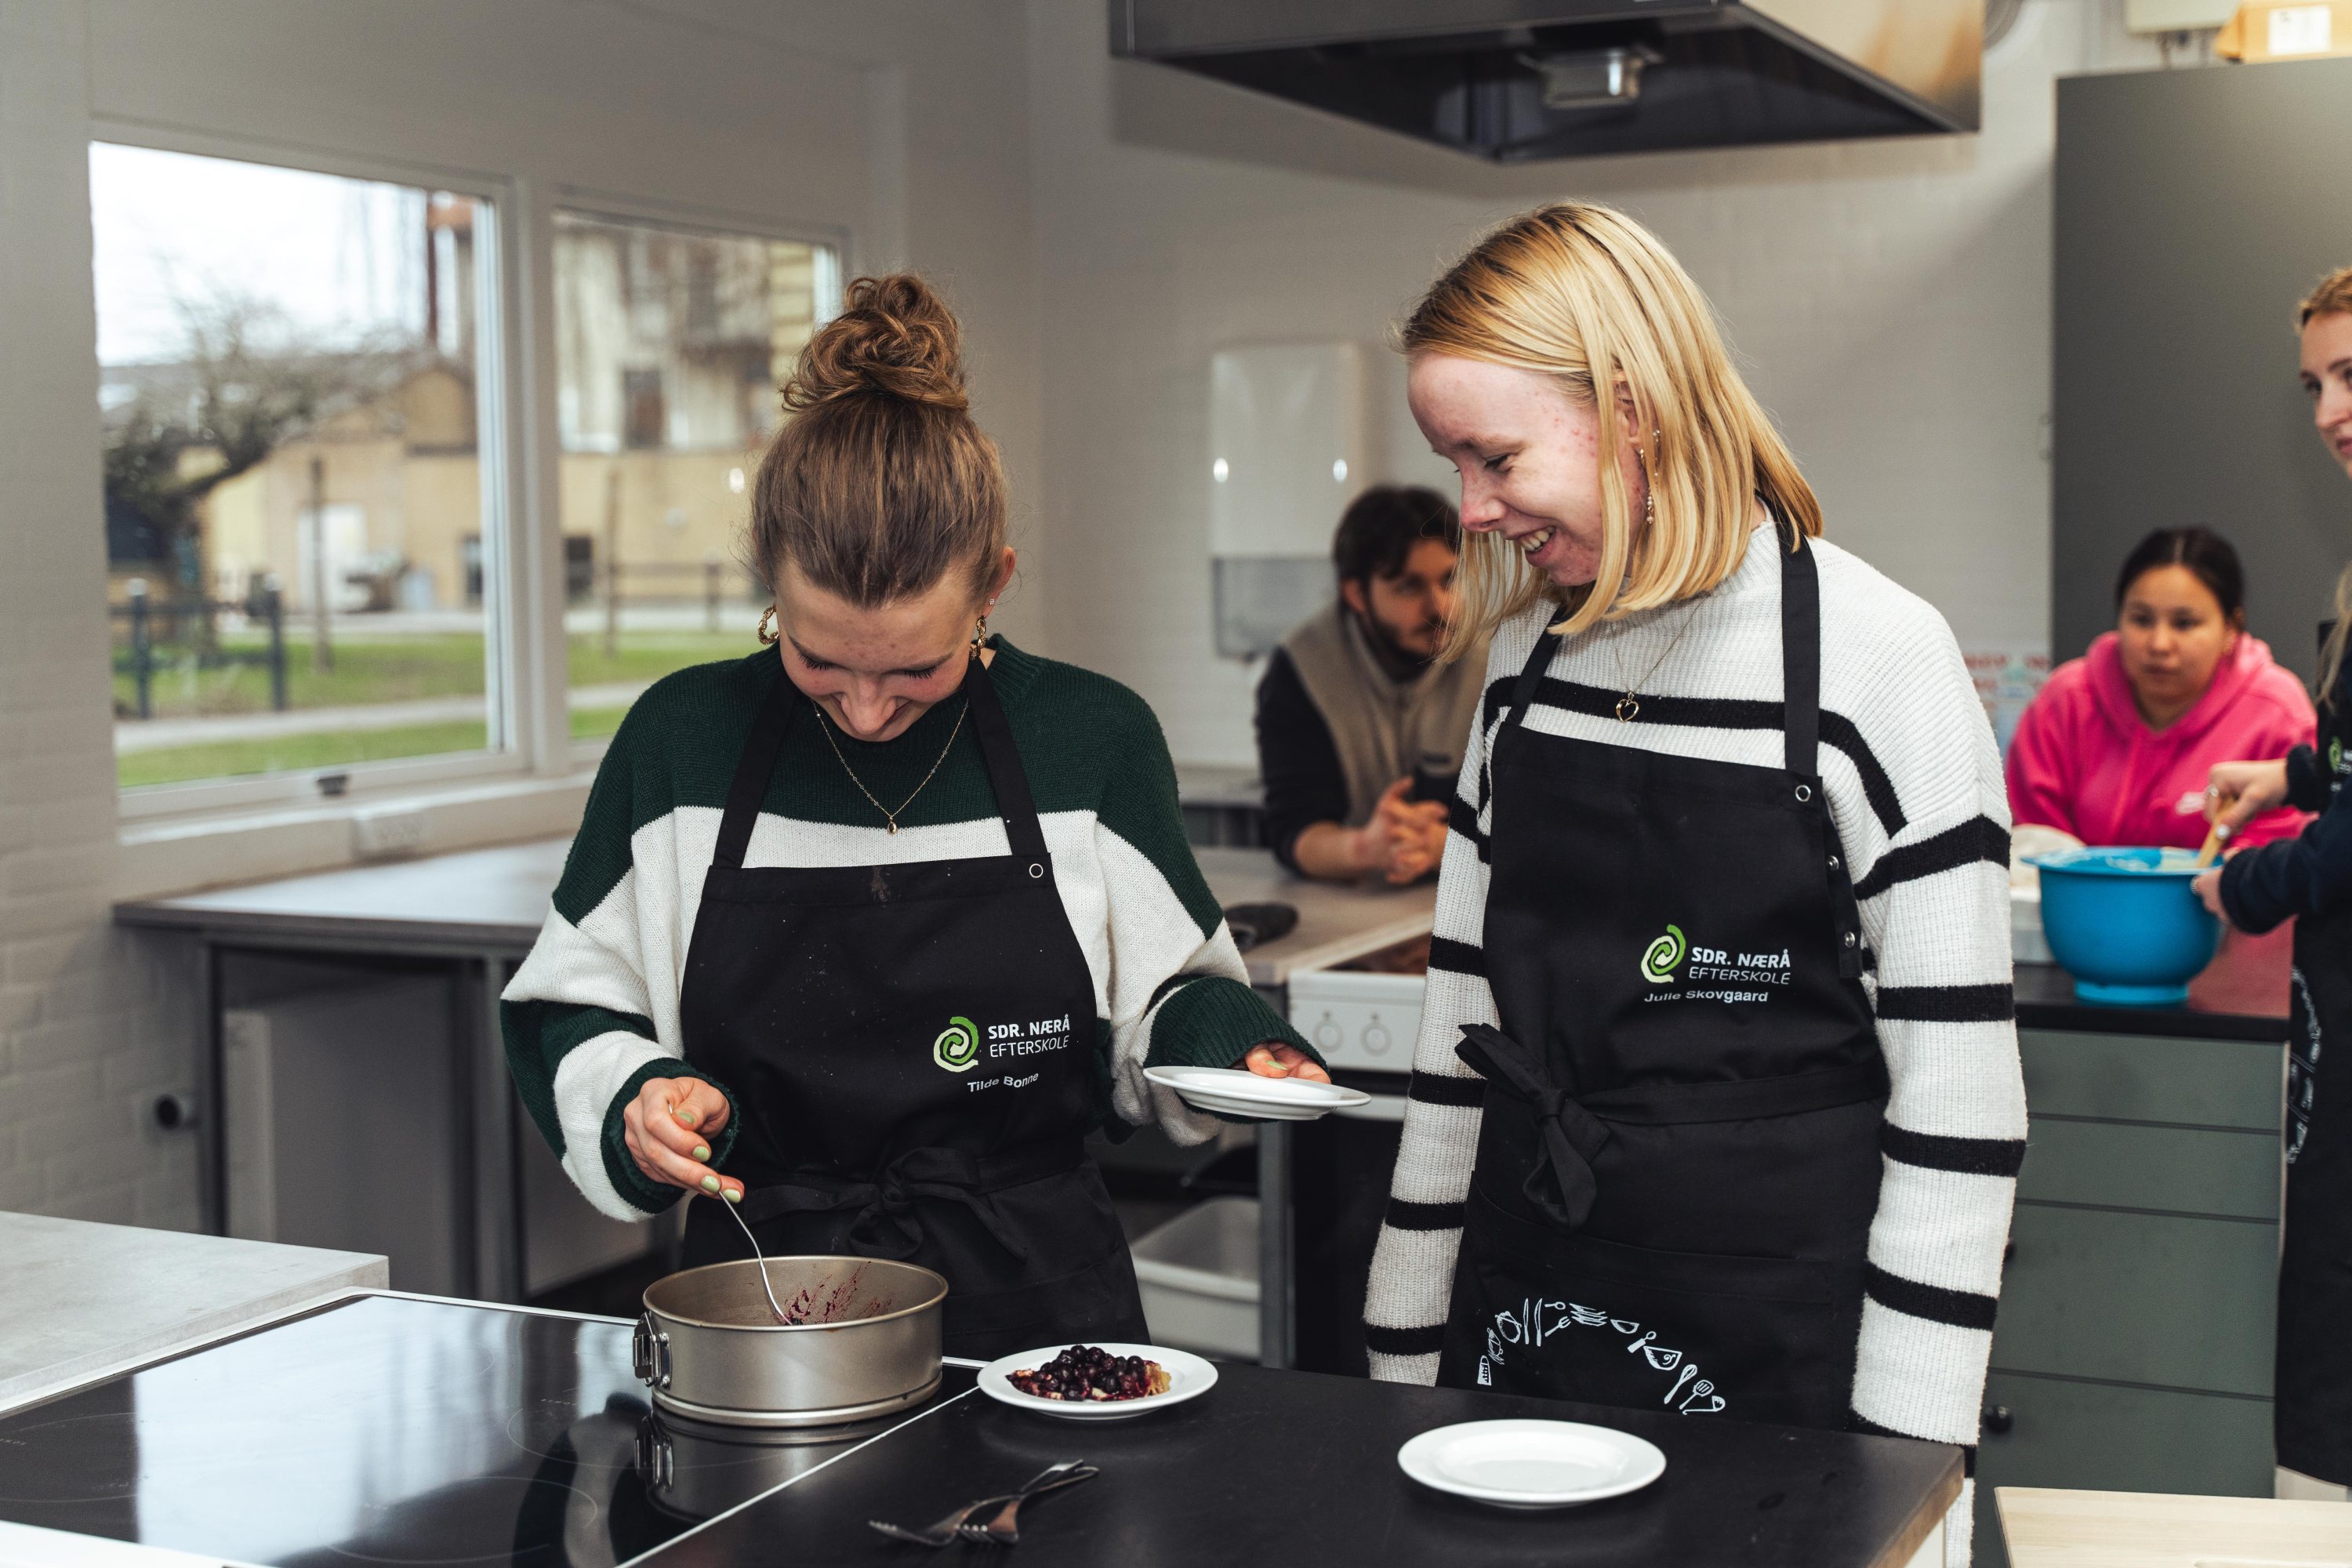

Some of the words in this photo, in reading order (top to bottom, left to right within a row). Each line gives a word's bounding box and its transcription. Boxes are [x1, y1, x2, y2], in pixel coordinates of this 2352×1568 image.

[1691, 947, 1731, 965] SDR.
[1737, 949, 1791, 968] NÆRÅ
[1689, 966, 1791, 985] EFTERSKOLE
[1644, 993, 1682, 1003] Julie
[1686, 990, 1769, 1004] Skovgaard
[988, 1023, 1025, 1040] SDR.
[1029, 1014, 1070, 1036] NÆRÅ
[989, 1035, 1070, 1058] EFTERSKOLE
[967, 1077, 1000, 1093] Tilde
[1003, 1073, 1039, 1088] Bonne
